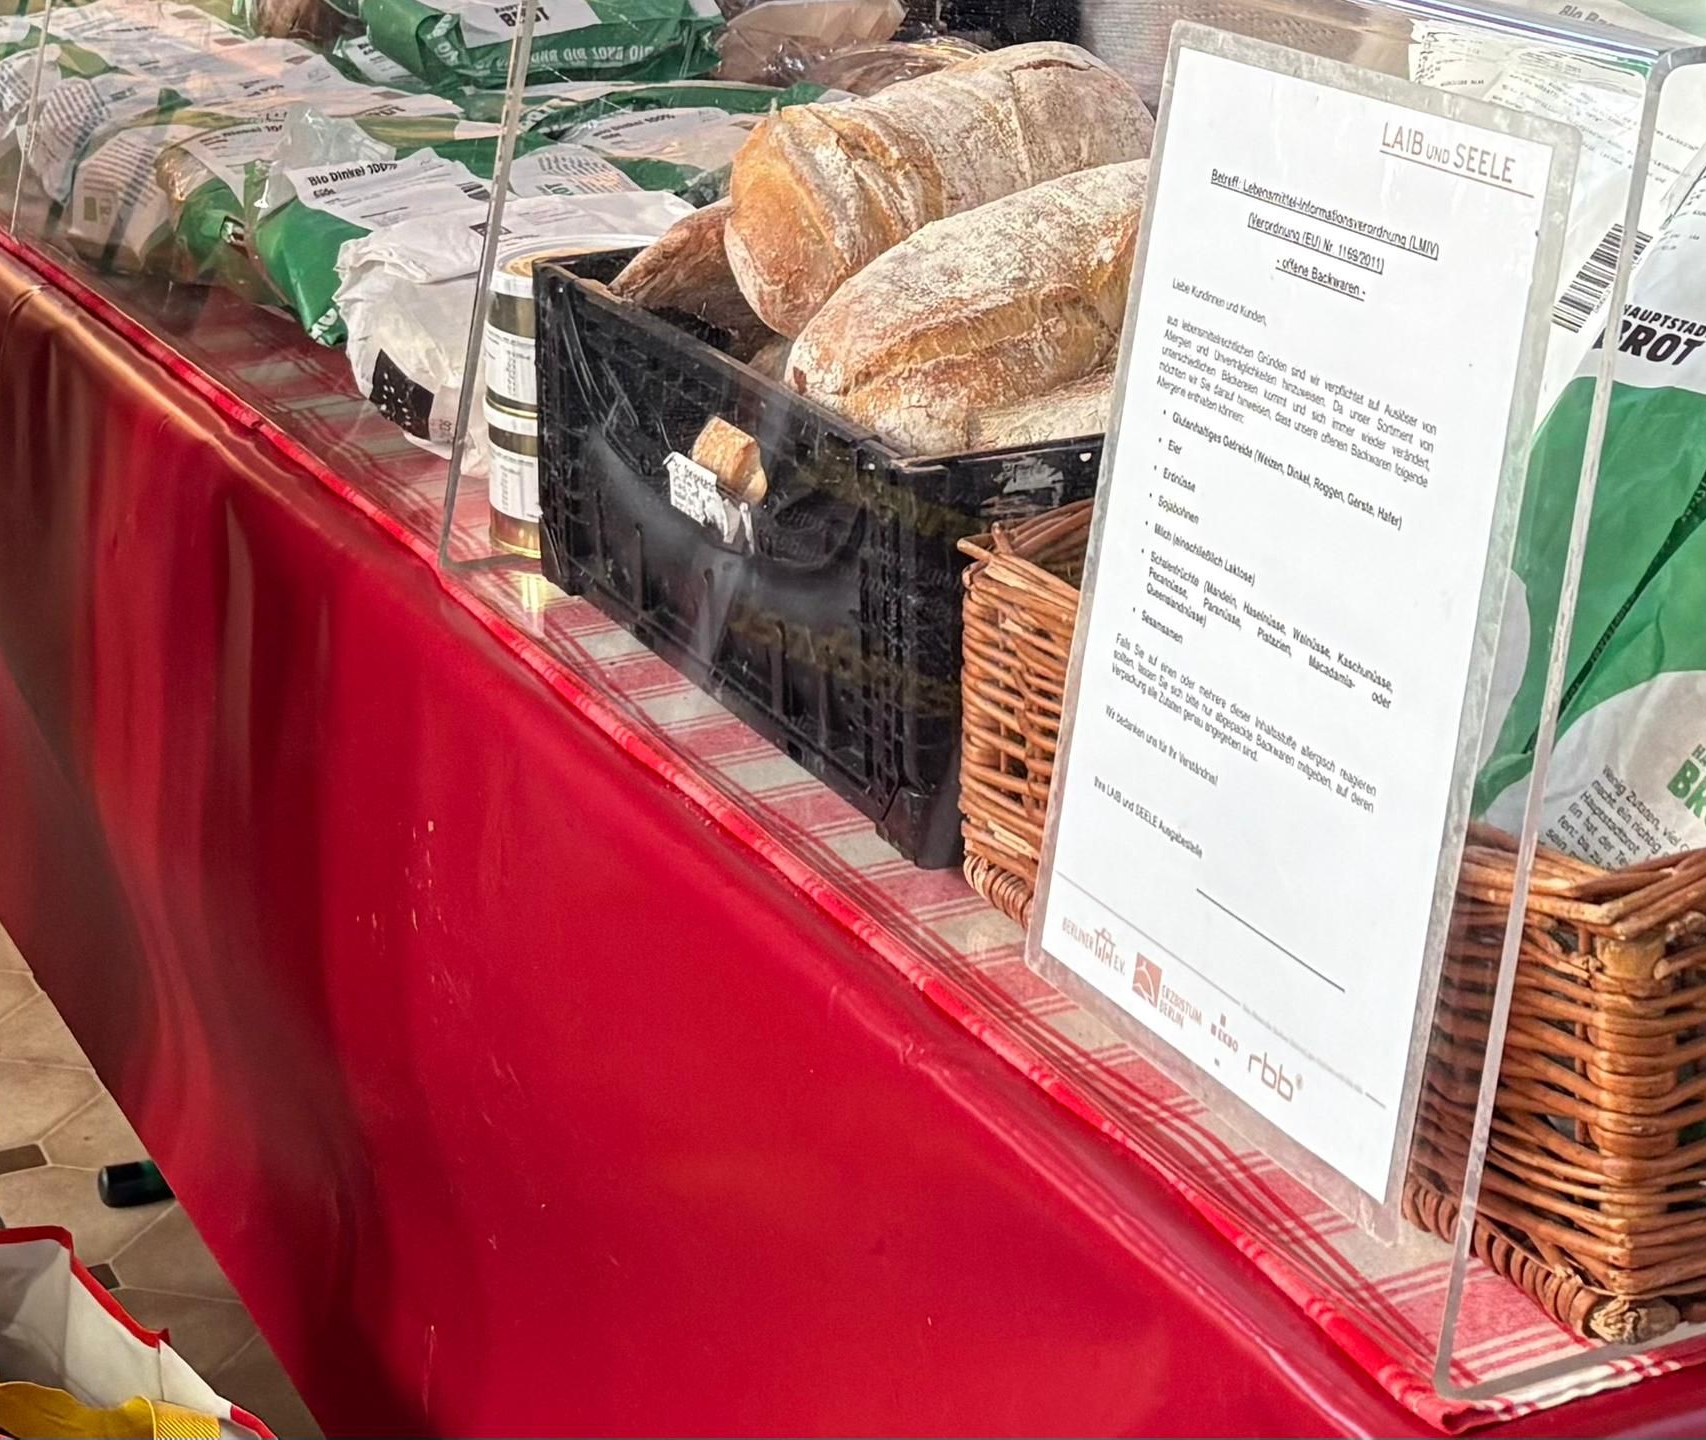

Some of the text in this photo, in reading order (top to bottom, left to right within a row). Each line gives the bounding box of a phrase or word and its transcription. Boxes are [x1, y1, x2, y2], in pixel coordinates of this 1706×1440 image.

[1381, 122, 1516, 184] LAIB UND SEELE
[307, 175, 329, 187] Bio
[329, 166, 366, 183] Dinkel
[1301, 230, 1322, 251] (EU)
[1167, 438, 1182, 456] Eier
[1615, 804, 1634, 824] ein
[1624, 789, 1665, 831] Zutaten,
[1597, 833, 1615, 852] der
[1161, 983, 1203, 1027] ERZBISTUM
[1248, 1051, 1294, 1102] rbb
